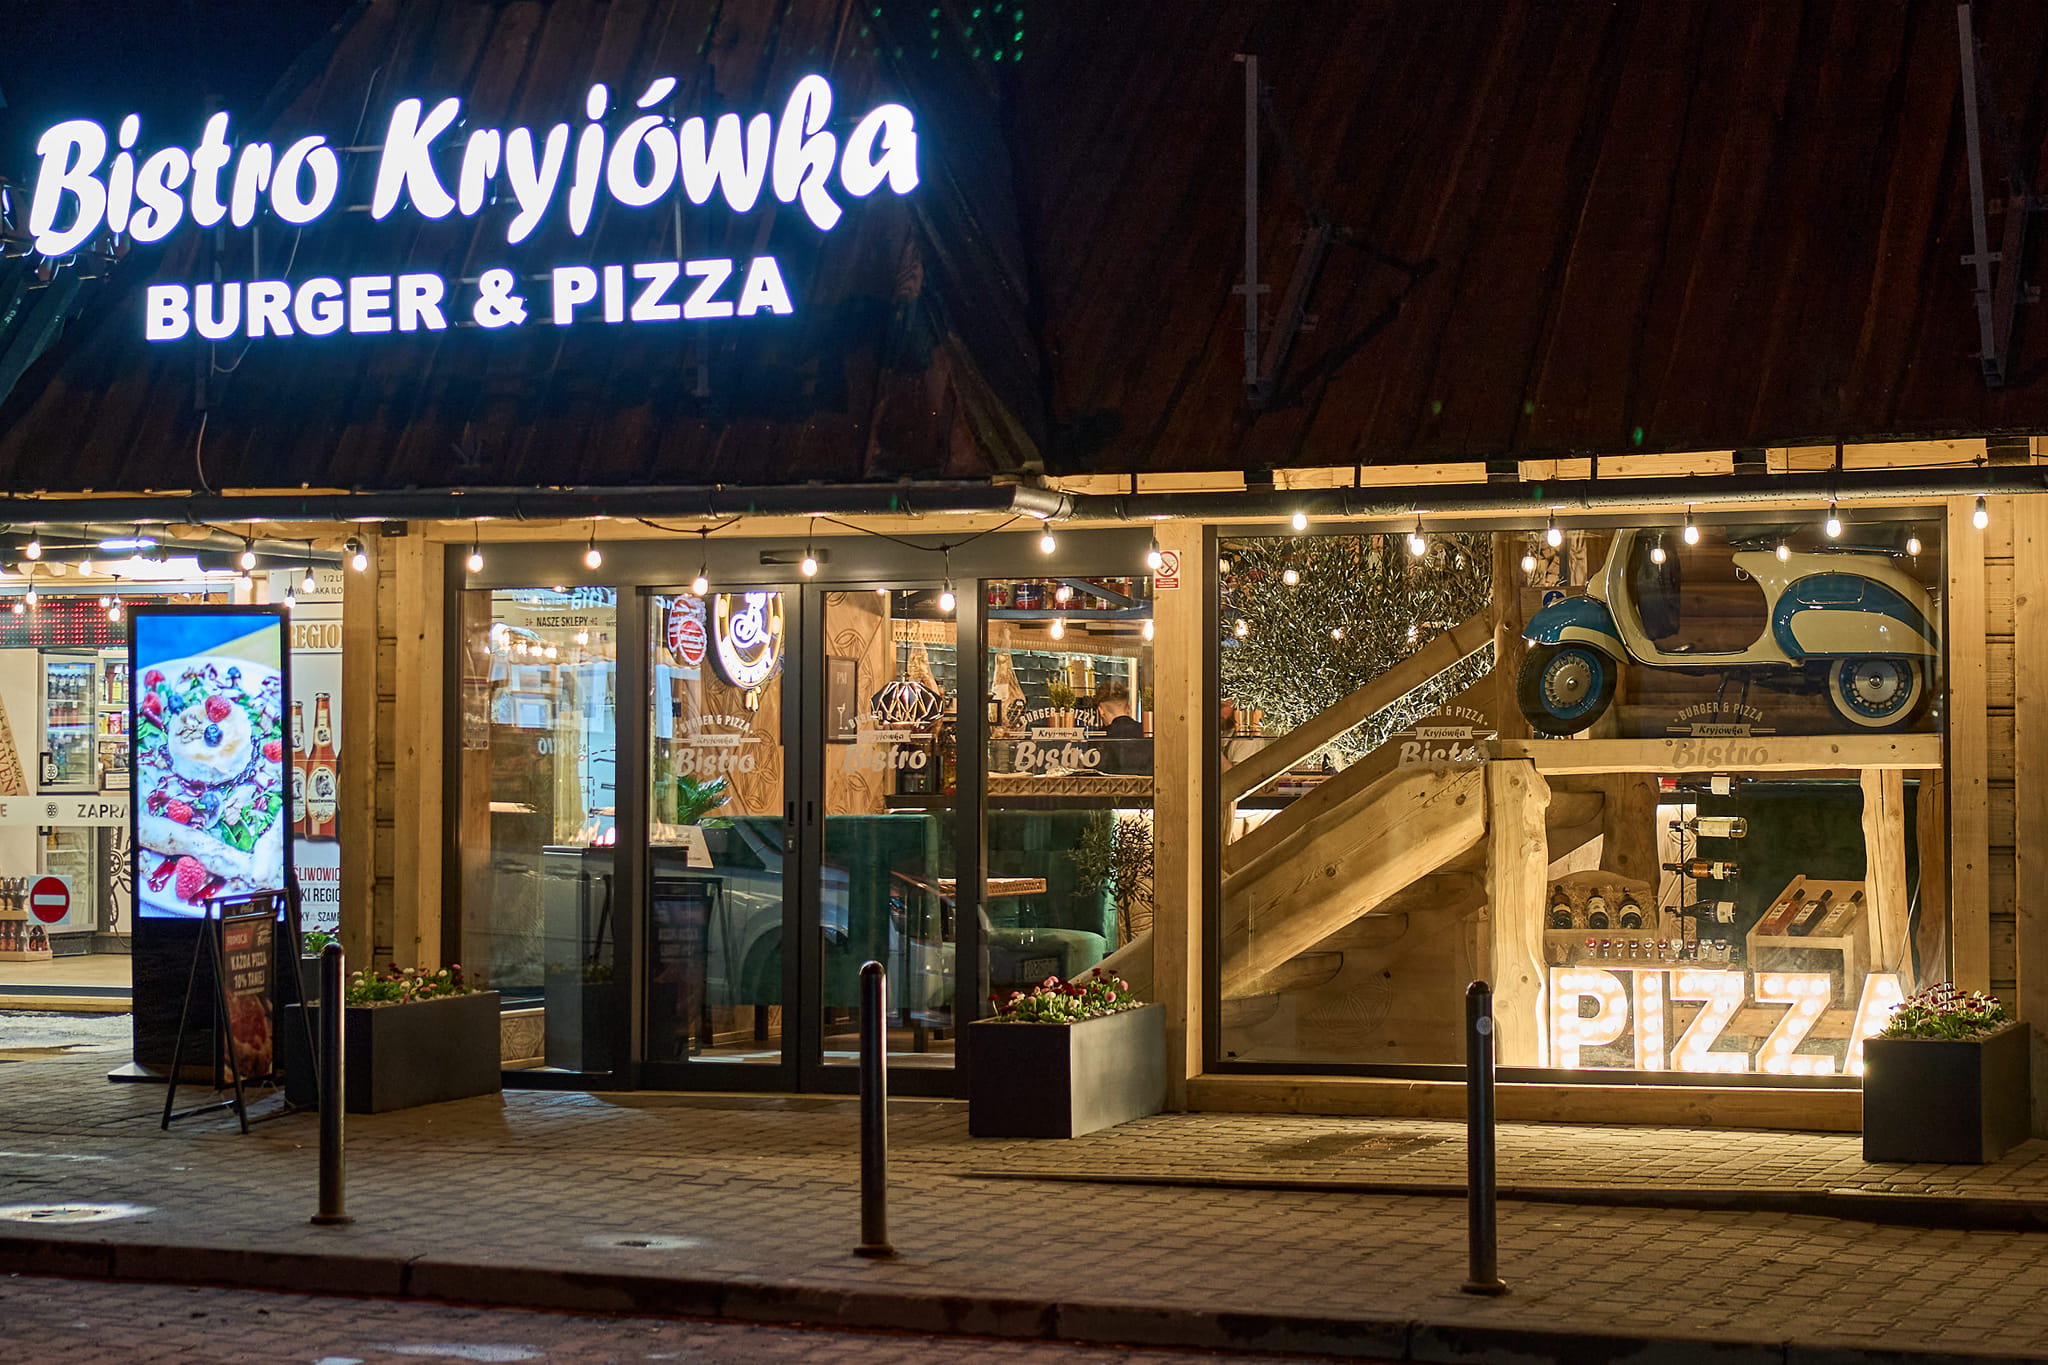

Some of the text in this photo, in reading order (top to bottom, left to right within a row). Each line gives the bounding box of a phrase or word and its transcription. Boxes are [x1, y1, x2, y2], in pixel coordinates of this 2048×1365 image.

[29, 74, 919, 257] Bistro Kryjówka
[146, 256, 794, 341] BURGER & PIZZA
[536, 616, 588, 627] NASZE SKLEPY
[725, 716, 751, 733] PIZZA
[1020, 707, 1056, 725] BURGER
[1456, 706, 1484, 725] PIZZA
[1678, 702, 1763, 722] BURGER & PIZZA
[675, 748, 754, 777] Bistro
[843, 743, 927, 774] Bistro
[1015, 742, 1100, 771] Bistro
[1672, 738, 1769, 769] Bistro
[1550, 966, 1904, 1076] PIZZA
